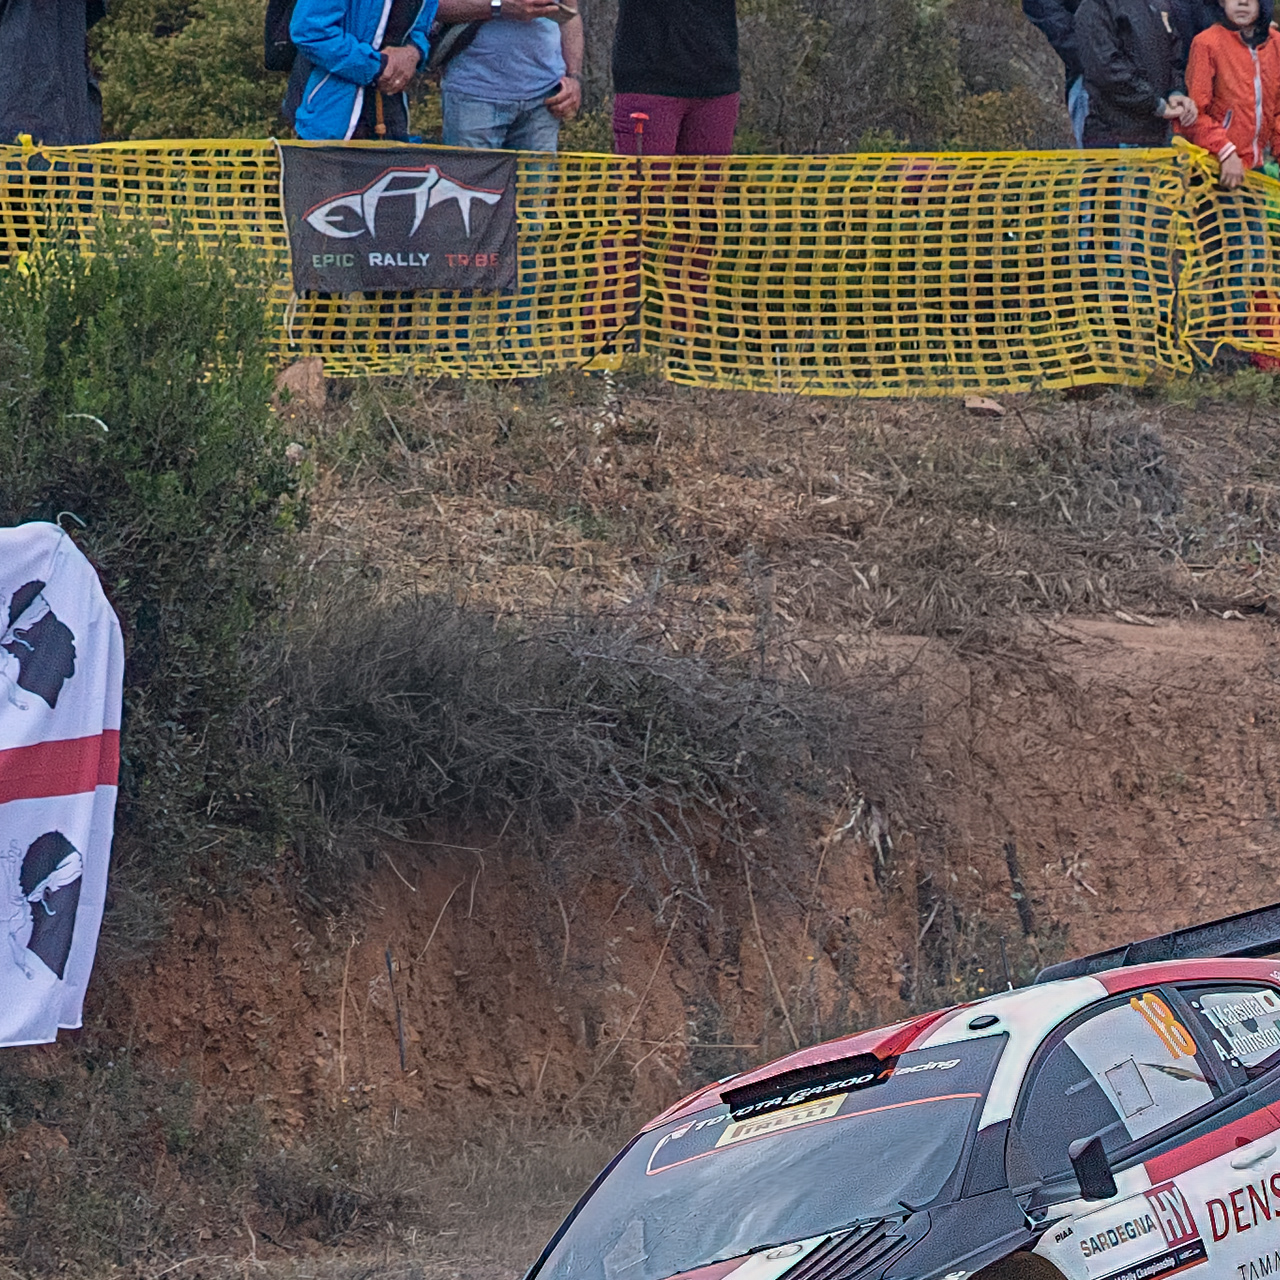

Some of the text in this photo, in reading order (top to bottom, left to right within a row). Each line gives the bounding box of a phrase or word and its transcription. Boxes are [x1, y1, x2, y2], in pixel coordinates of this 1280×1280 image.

[312, 253, 500, 268] EPIC RALLY TRBE
[1130, 993, 1197, 1059] 18
[693, 1095, 783, 1131] TOYOTA
[780, 1074, 875, 1105] GAZOO
[730, 1100, 835, 1140] PIRELLI
[1055, 1227, 1074, 1243] PIAA
[1079, 1214, 1158, 1258] SARDEGNA
[1136, 1256, 1176, 1279] Championship
